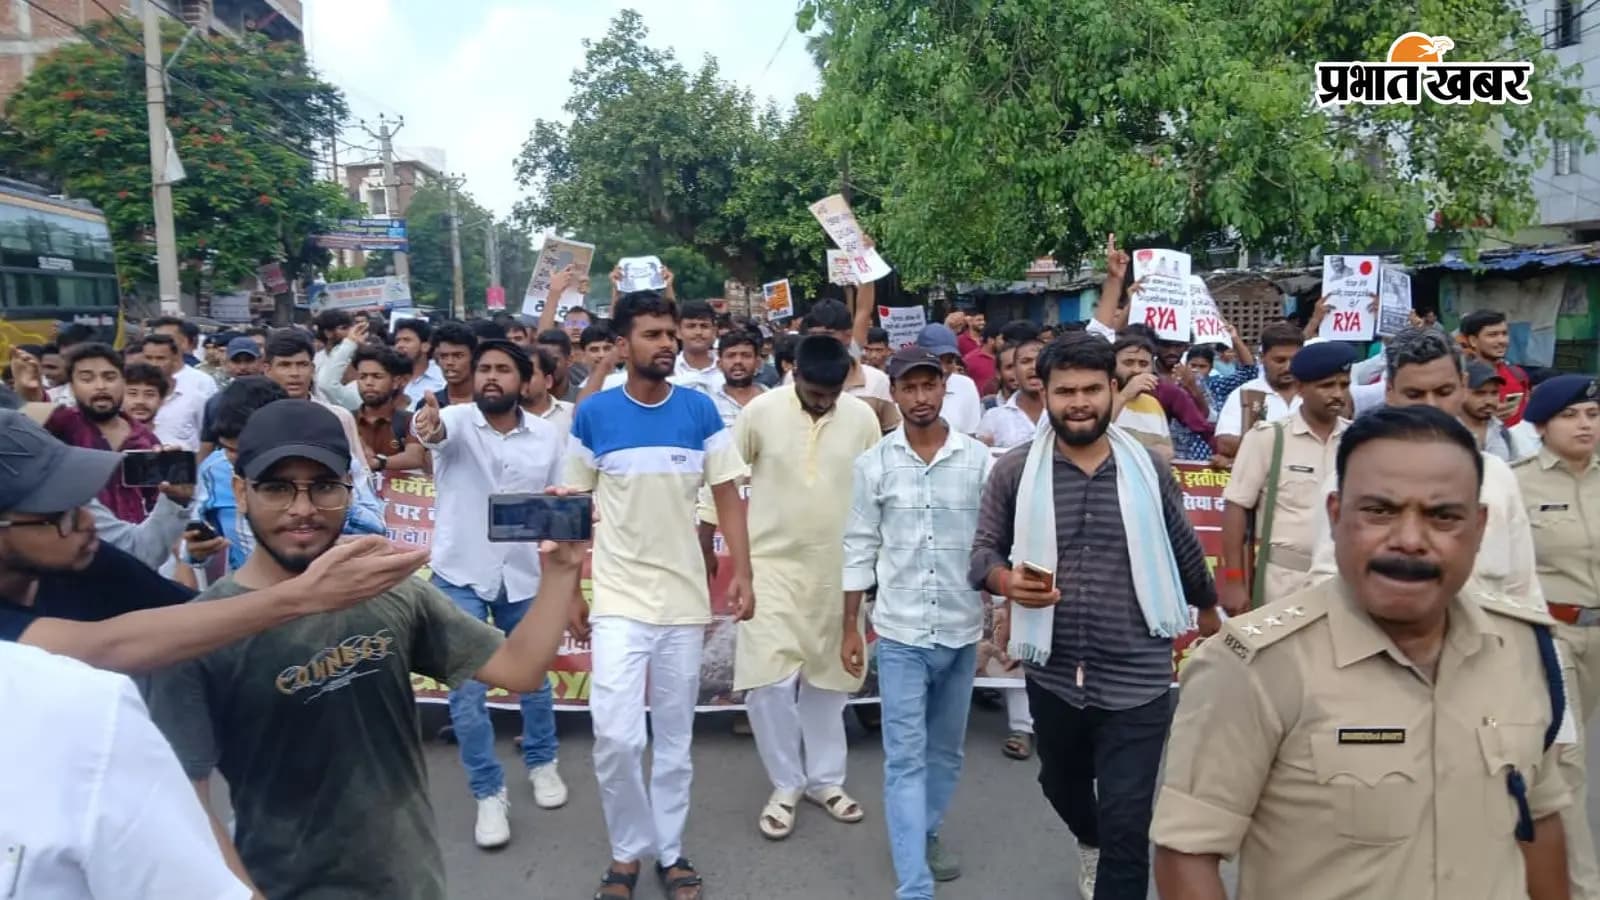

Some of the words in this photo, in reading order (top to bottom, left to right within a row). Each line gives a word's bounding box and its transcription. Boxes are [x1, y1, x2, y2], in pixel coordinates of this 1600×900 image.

[1145, 306, 1177, 331] RYA
[1333, 311, 1360, 331] RYA
[394, 503, 425, 521] पर
